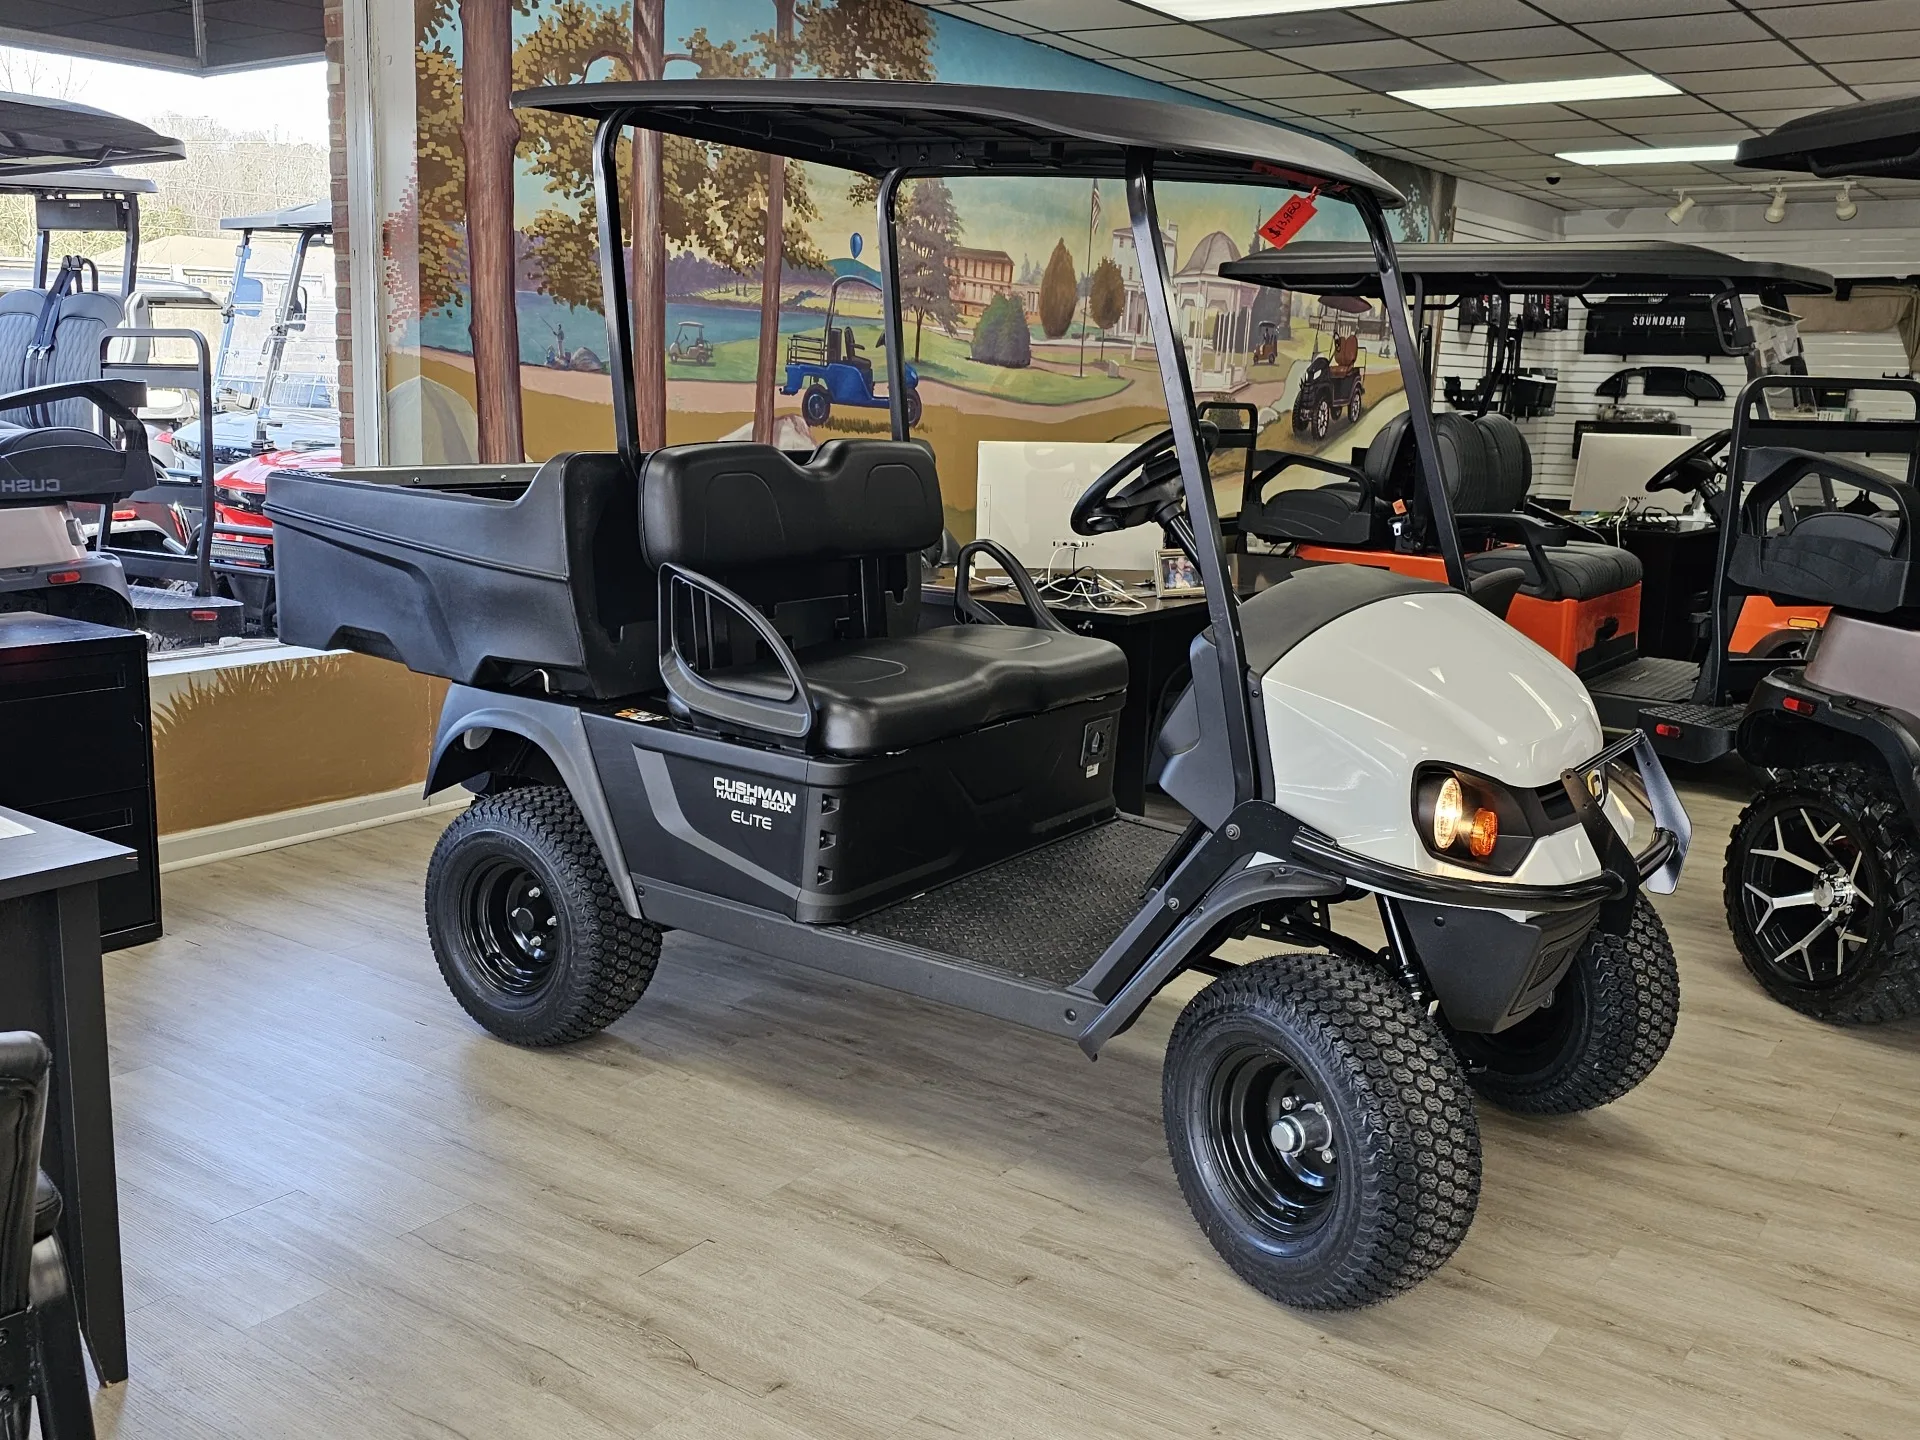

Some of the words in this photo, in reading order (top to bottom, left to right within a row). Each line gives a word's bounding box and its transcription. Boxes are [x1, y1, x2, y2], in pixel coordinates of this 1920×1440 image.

[1632, 316, 1686, 326] SOUNDBAR
[713, 776, 797, 806] CUSHMAN
[716, 790, 757, 806] HAULER
[730, 809, 772, 830] ELITE
